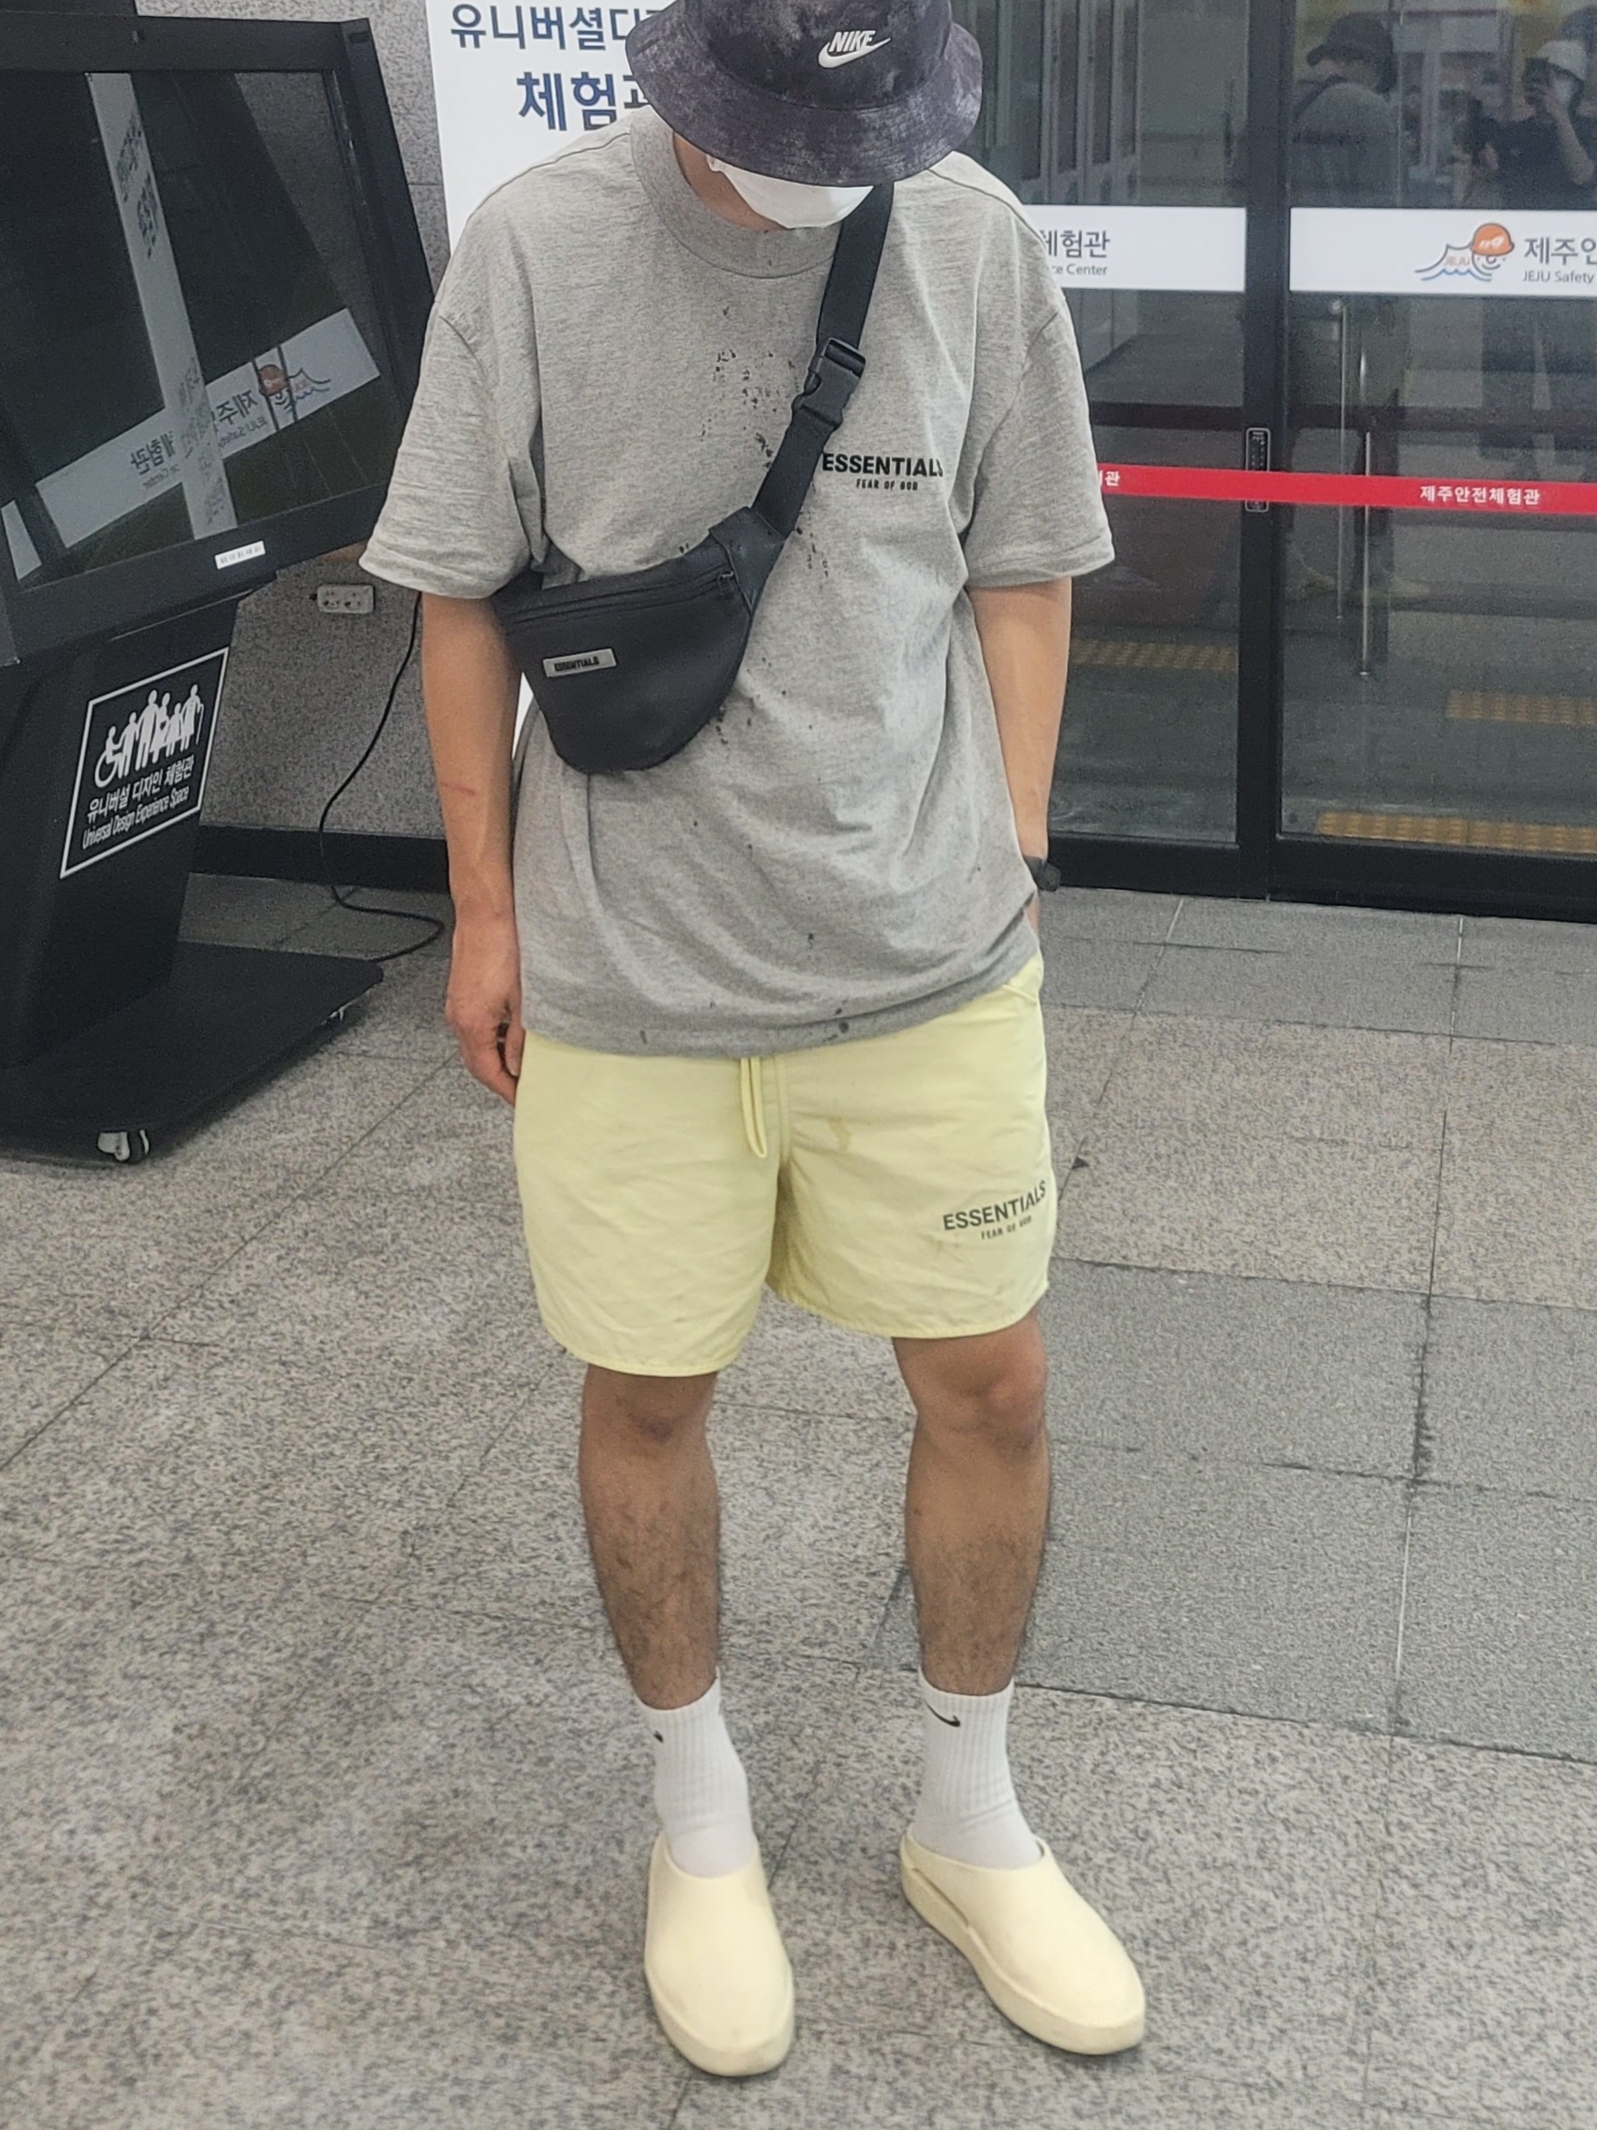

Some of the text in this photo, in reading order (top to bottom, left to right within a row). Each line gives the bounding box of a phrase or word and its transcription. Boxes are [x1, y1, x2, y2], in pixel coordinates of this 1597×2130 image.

[451, 3, 664, 51] 유니버셜디
[828, 30, 876, 52] NIKE
[1066, 263, 1108, 275] Center
[1522, 270, 1595, 285] JEJU Safety
[856, 478, 919, 491] FEAR OF GOD
[1420, 485, 1540, 505] 제주안전체험관
[132, 769, 164, 801] 디자인
[164, 754, 195, 786] 체험관
[82, 786, 190, 850] Universal Design Experience Space
[943, 1180, 1046, 1231] ESSENTIALS
